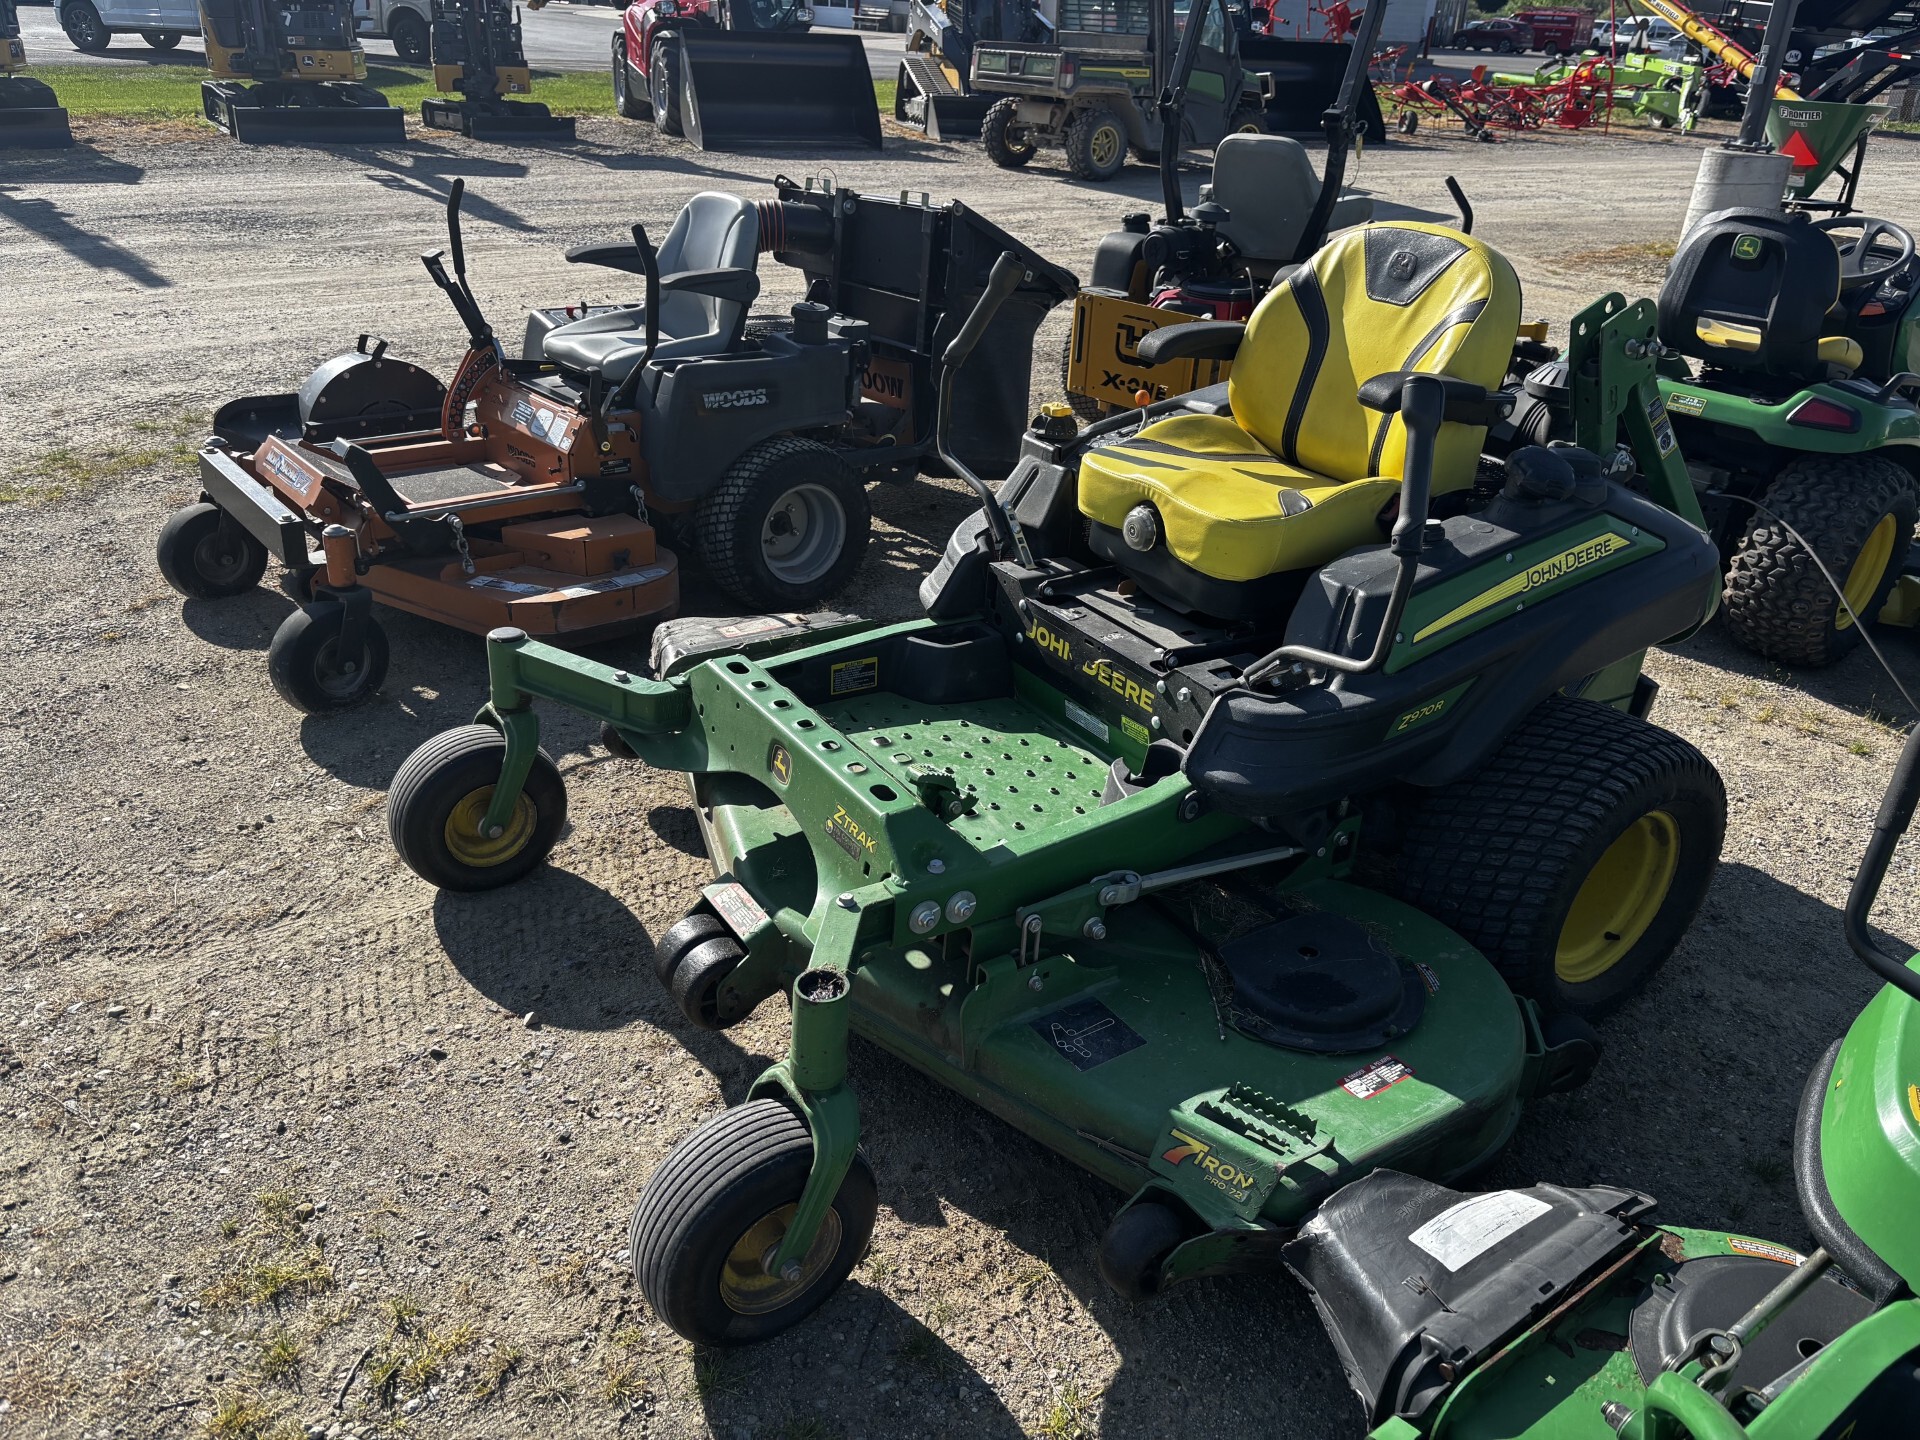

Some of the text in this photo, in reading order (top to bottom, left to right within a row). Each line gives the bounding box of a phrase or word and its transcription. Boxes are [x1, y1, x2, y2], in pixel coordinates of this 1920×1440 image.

[1655, 2, 1680, 20] WESTFIELD
[1779, 105, 1822, 120] FRONTIER
[702, 388, 767, 409] WOODS
[1101, 369, 1169, 401] X-ONE
[1522, 538, 1613, 591] JOHN DEERE
[1398, 699, 1445, 731] Z970R
[833, 804, 878, 854] ZTRAK
[1203, 1174, 1243, 1200] PRO 72
